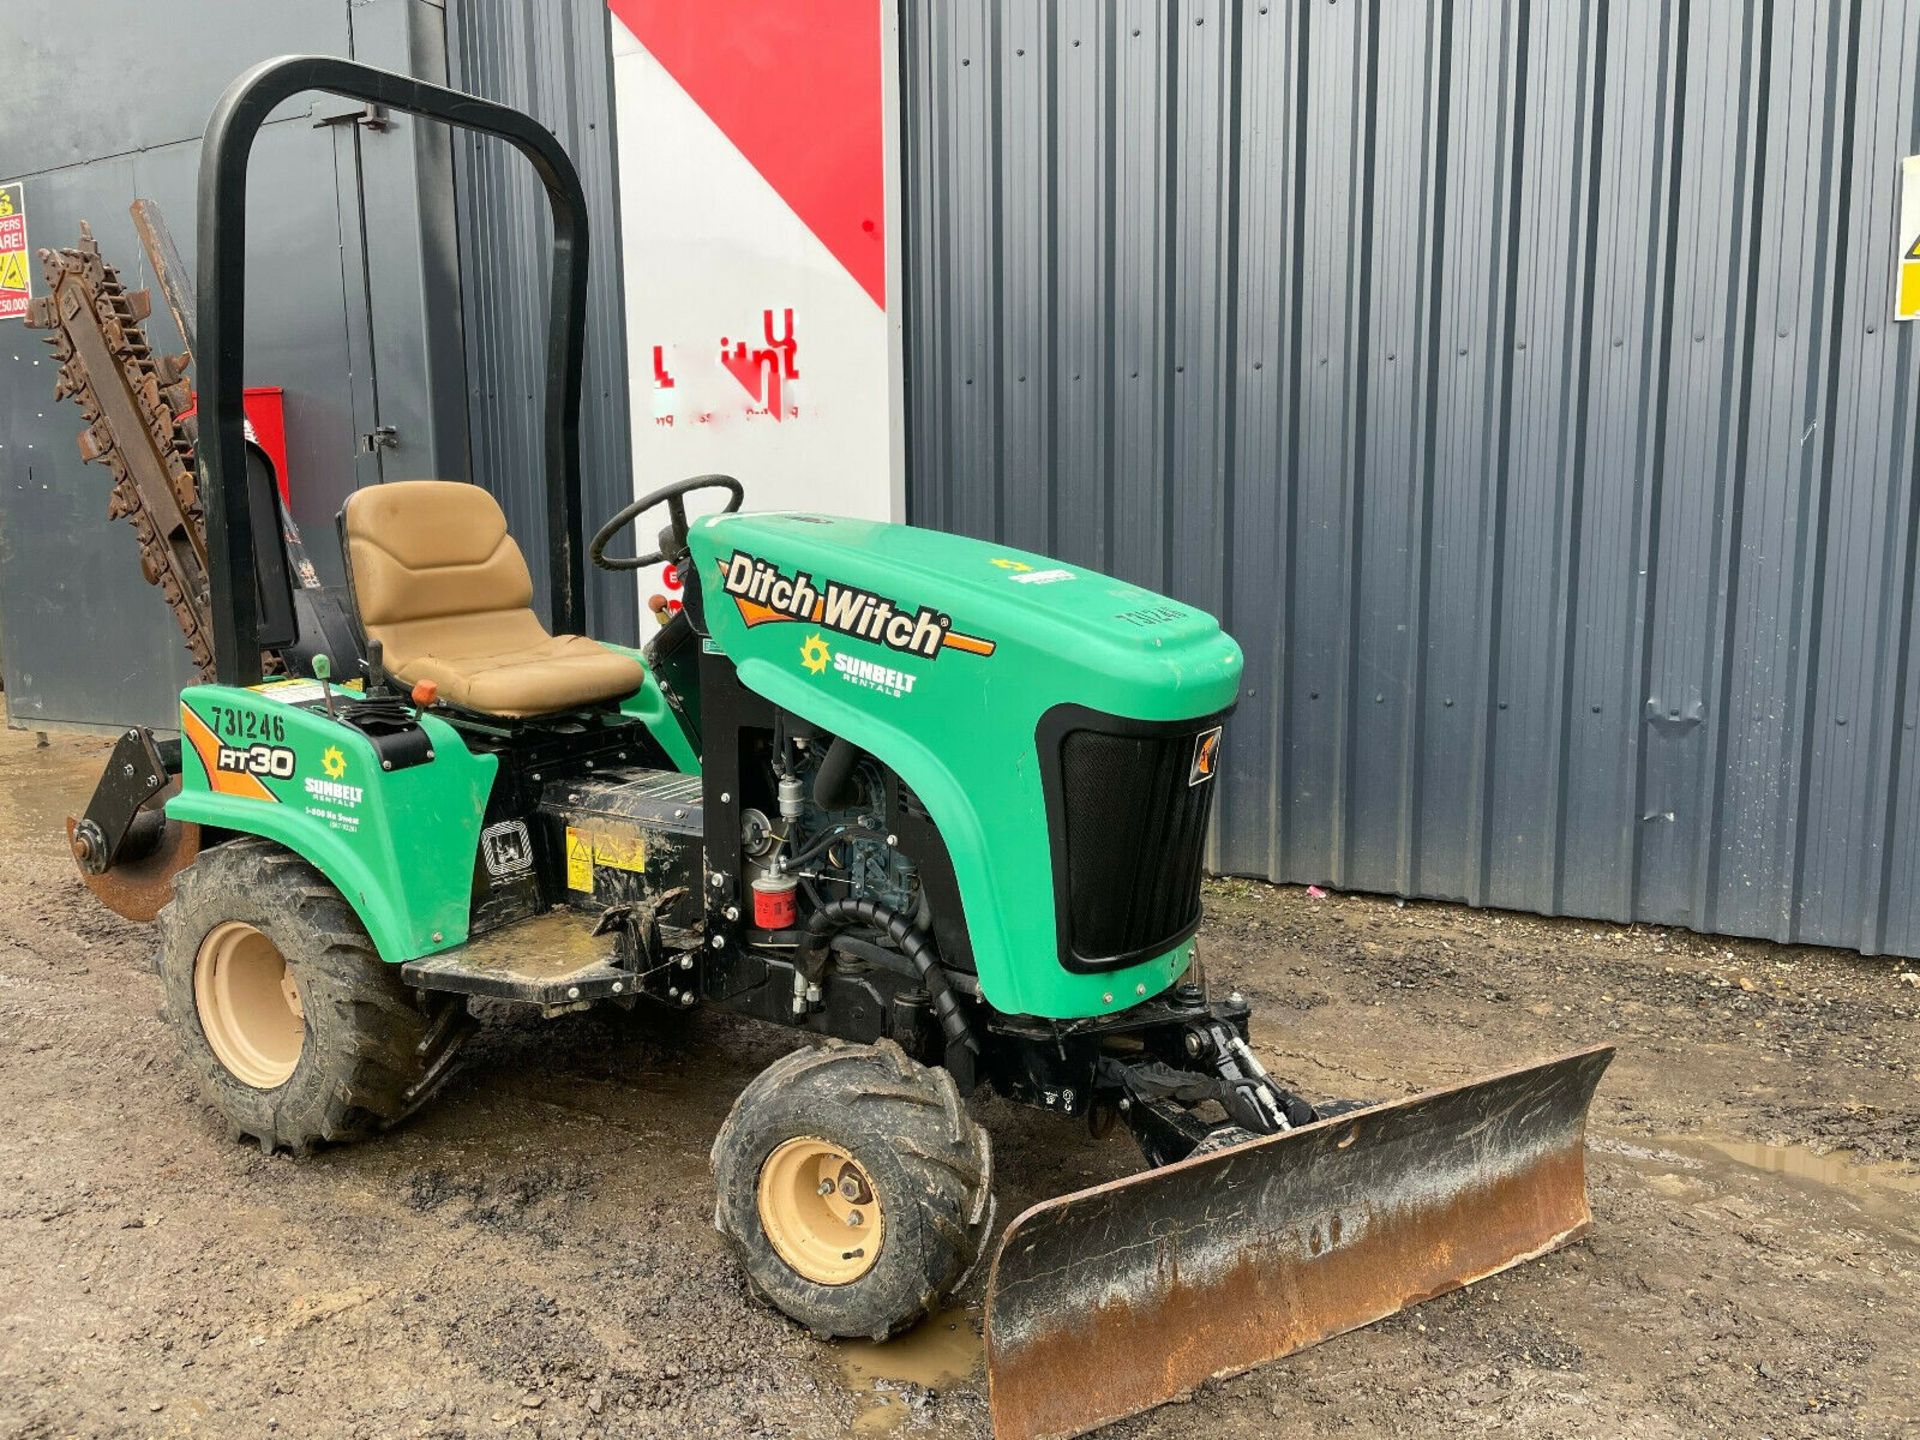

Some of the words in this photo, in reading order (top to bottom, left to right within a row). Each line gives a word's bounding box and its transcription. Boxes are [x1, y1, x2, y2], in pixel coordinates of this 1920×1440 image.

[725, 553, 815, 618] Ditch
[833, 651, 917, 694] SUNBELT
[842, 673, 902, 698] RENTALS
[211, 706, 285, 742] 731246
[304, 777, 363, 804] SUNBELT
